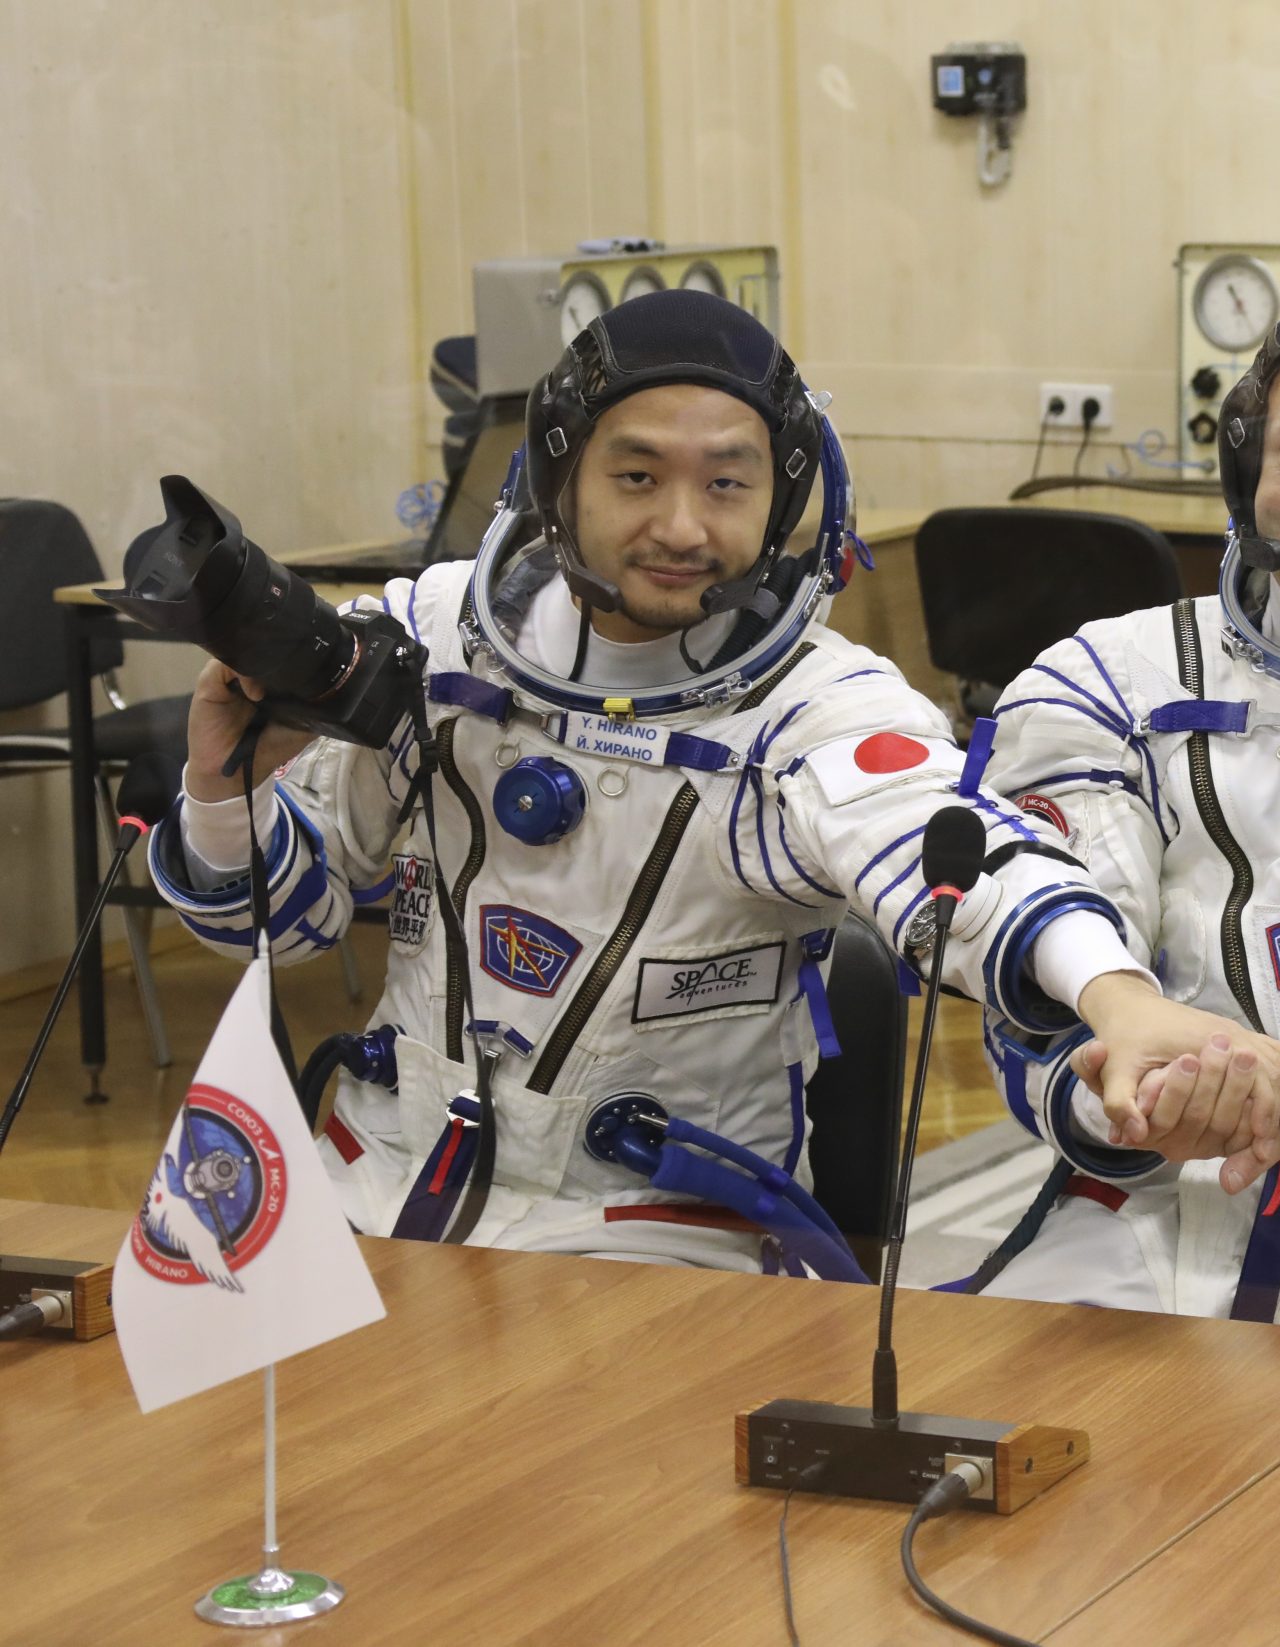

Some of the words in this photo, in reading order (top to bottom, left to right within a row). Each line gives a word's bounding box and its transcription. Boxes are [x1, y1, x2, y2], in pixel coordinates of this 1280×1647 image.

[349, 612, 371, 620] SONY
[582, 716, 592, 729] Y.
[597, 719, 657, 741] HIRANO
[576, 735, 589, 750] Й.
[593, 739, 653, 761] ХИРАНО
[394, 857, 432, 891] WORL
[668, 958, 753, 997] SPACE
[680, 980, 748, 999] adventures
[226, 1101, 263, 1136] СОЮЗ
[268, 1167, 281, 1213] МС-20
